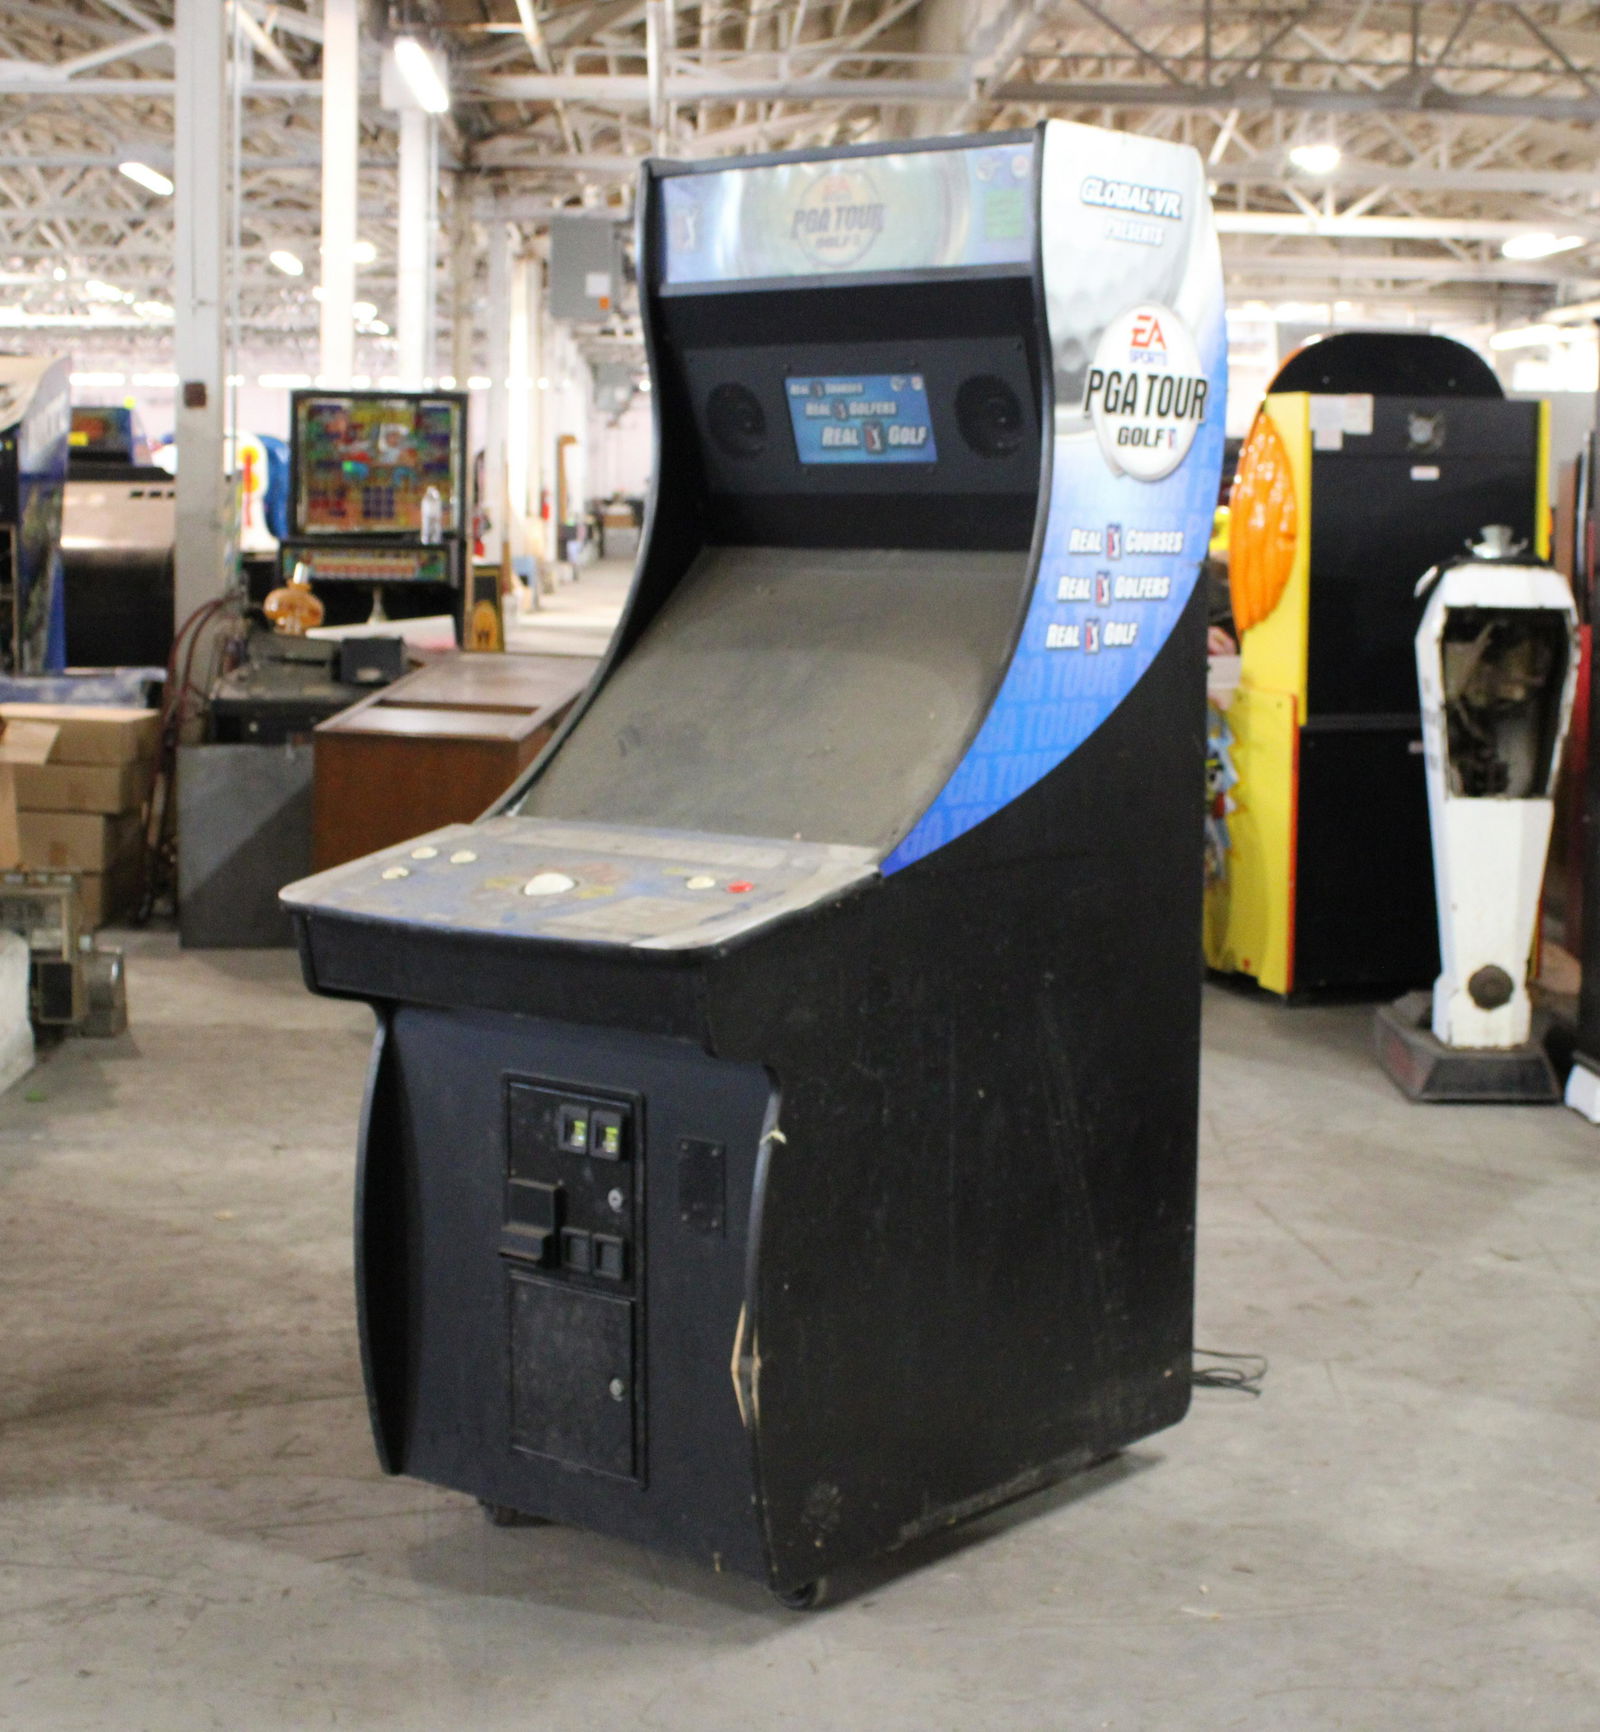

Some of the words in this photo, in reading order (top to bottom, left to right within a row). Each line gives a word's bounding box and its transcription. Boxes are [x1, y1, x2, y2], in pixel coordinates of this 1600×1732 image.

[790, 207, 831, 240] PGA
[835, 203, 885, 233] TOUR
[1130, 314, 1167, 351] EA
[1129, 350, 1168, 366] SPORTS
[1083, 369, 1138, 418] PGA
[1144, 375, 1209, 421] TOUR
[822, 426, 860, 447] REAL
[888, 425, 928, 446] GOLF
[1117, 426, 1164, 449] GOLF
[1068, 528, 1102, 554] REAL
[1125, 530, 1184, 555] COURSES
[1057, 576, 1091, 601] REAL
[1114, 575, 1171, 600] GOLFERS
[1045, 624, 1080, 650] REAL
[1103, 622, 1138, 647] GOLF
